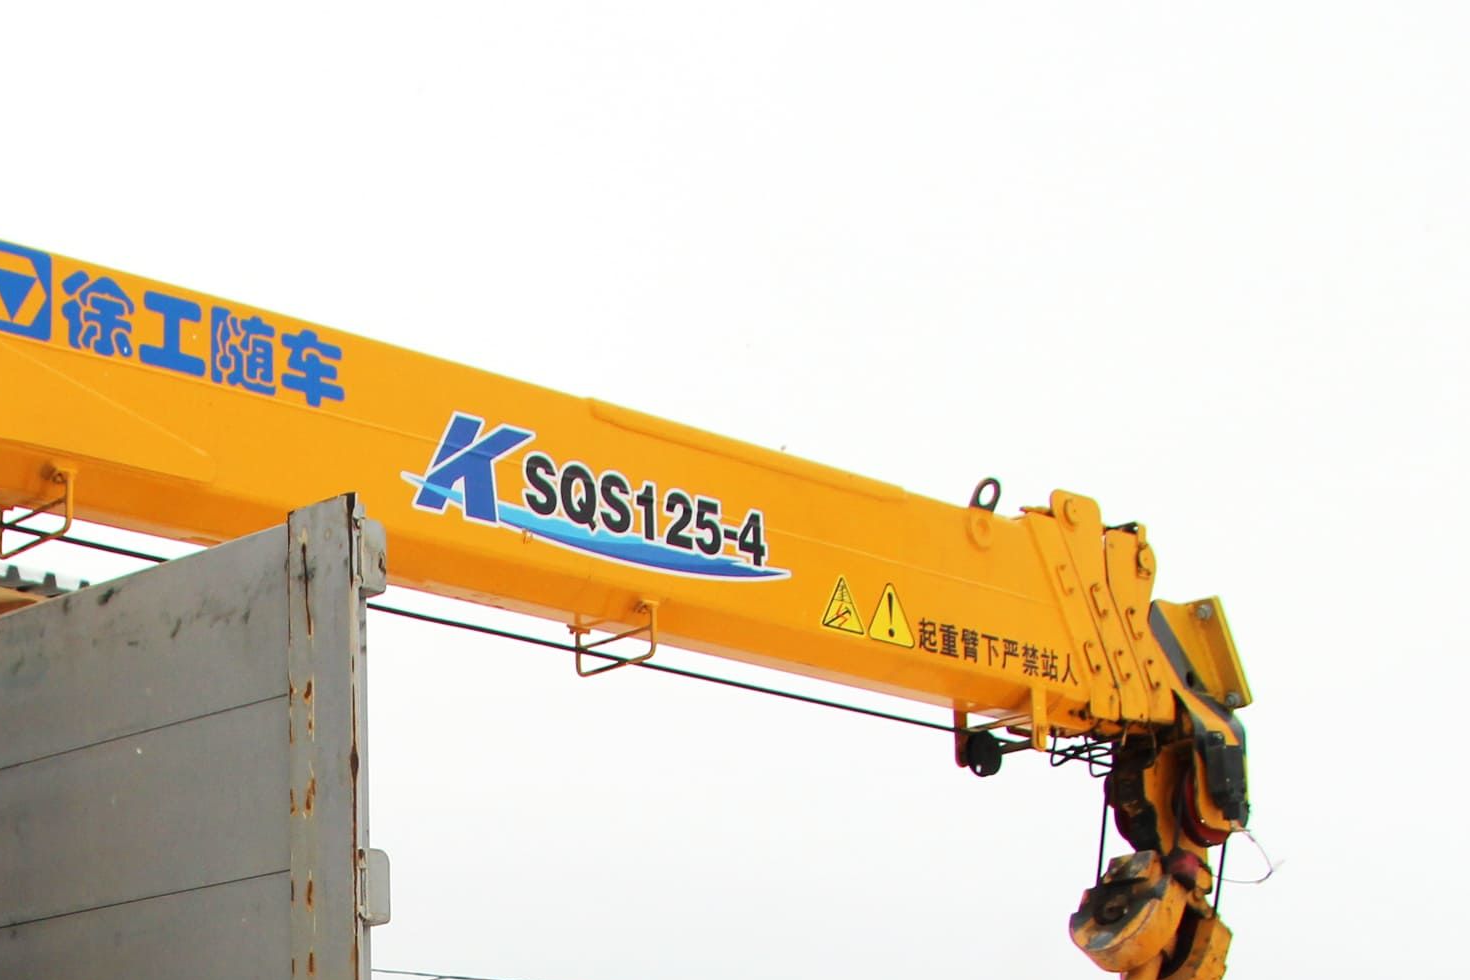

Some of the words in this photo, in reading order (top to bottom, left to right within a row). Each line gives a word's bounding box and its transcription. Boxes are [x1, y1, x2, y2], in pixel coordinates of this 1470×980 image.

[61, 270, 345, 407] 徐工随车
[524, 454, 766, 567] SQS125-4
[917, 617, 1079, 686] 起重臂下严禁站人
